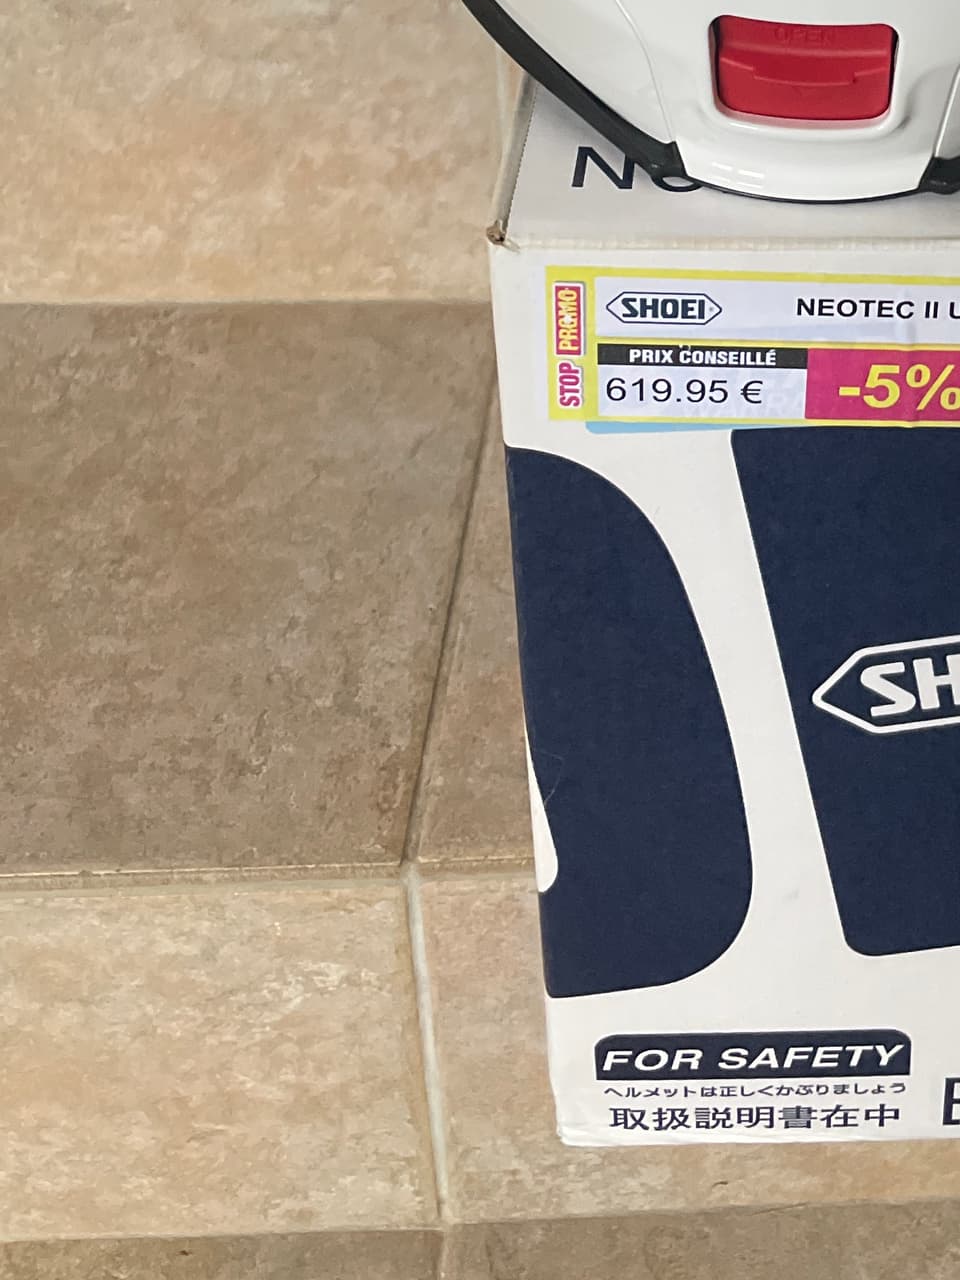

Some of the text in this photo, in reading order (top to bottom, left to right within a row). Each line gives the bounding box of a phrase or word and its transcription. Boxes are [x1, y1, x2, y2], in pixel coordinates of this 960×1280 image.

[557, 285, 582, 354] PROMO
[620, 296, 707, 320] SHOEI
[796, 297, 914, 320] NEOTEC
[924, 301, 940, 320] II
[628, 346, 777, 367] PRIX CONSEILLÉ
[558, 361, 583, 408] STOP
[605, 377, 764, 406] 619.95 €
[602, 1044, 904, 1072] FOR SAFETY
[604, 1082, 907, 1099] ヘルメットは正しくかぶりましょう
[608, 1104, 901, 1131] 取扱説明書在中
